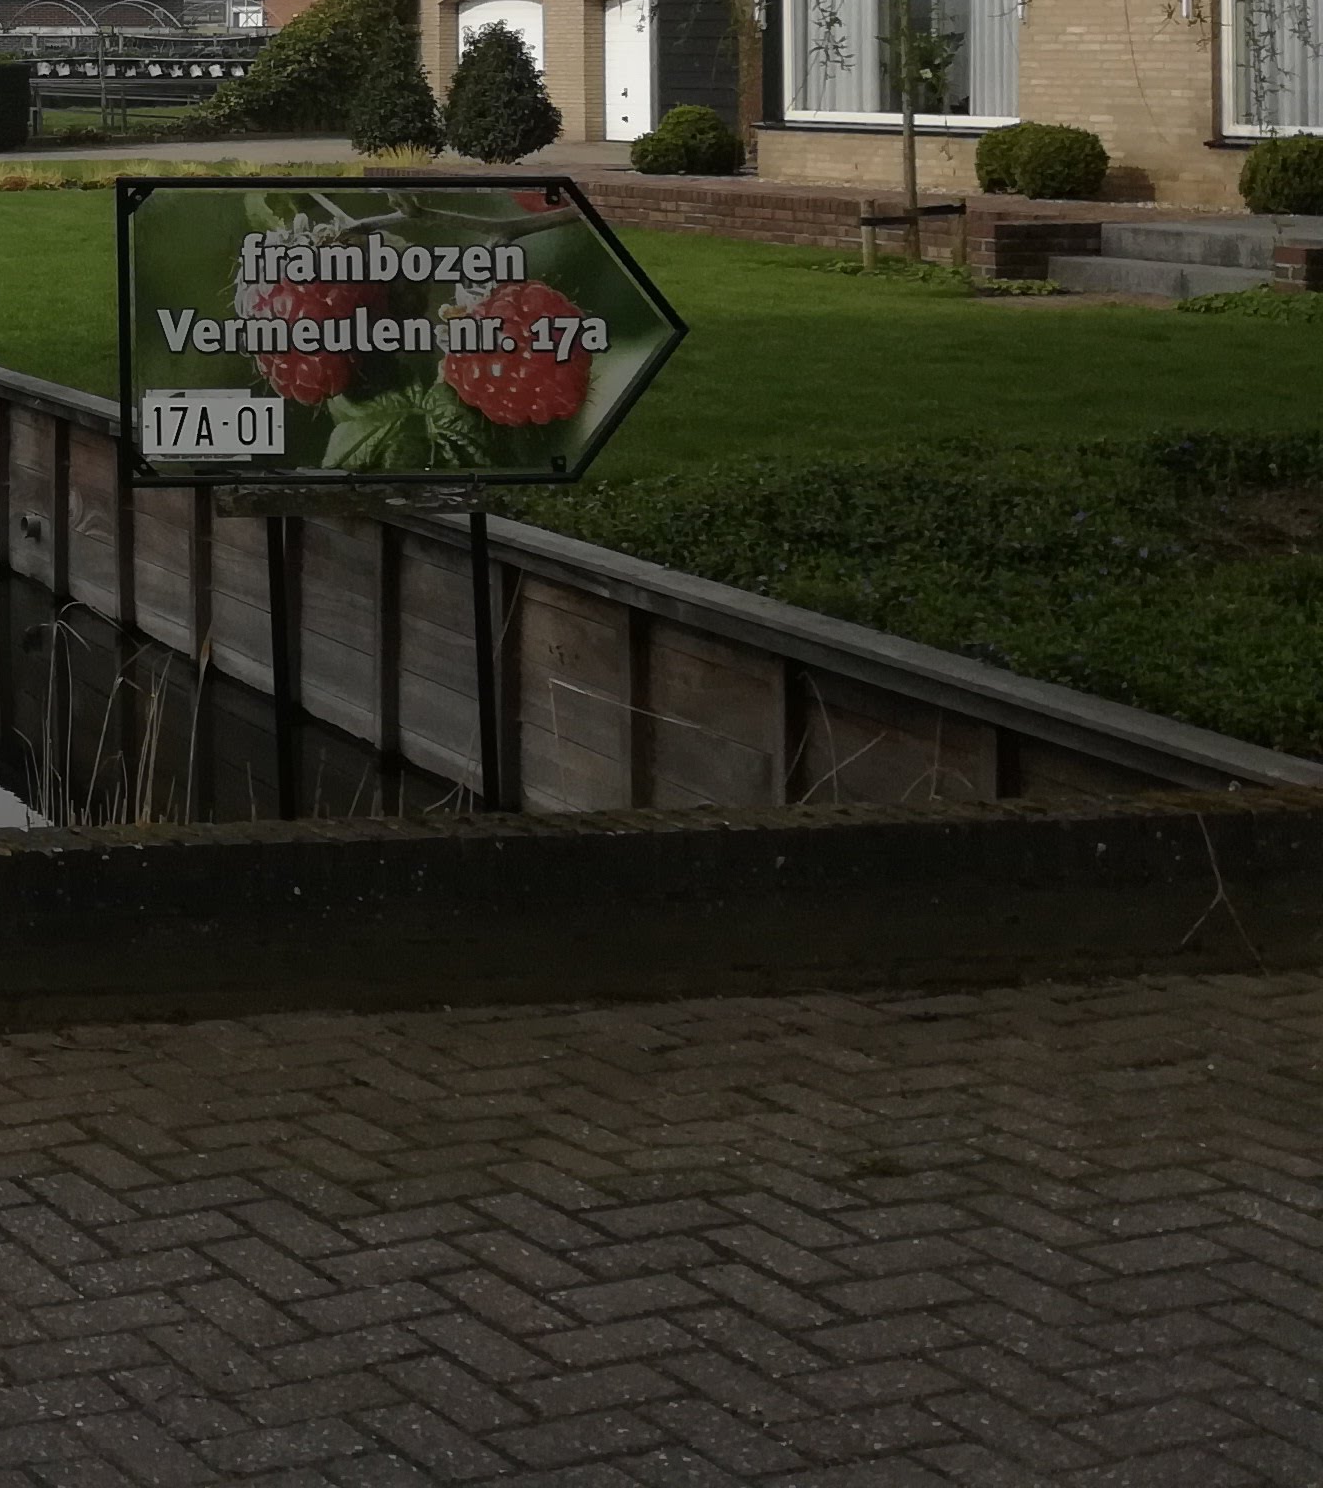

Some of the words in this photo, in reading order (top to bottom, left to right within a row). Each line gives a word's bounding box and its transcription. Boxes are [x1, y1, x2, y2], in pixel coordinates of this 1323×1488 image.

[241, 233, 526, 281] frambozen
[156, 307, 432, 352] Vermeulen
[449, 316, 517, 352] nr.
[529, 316, 610, 363] 17a
[153, 406, 274, 446] 17A-01
